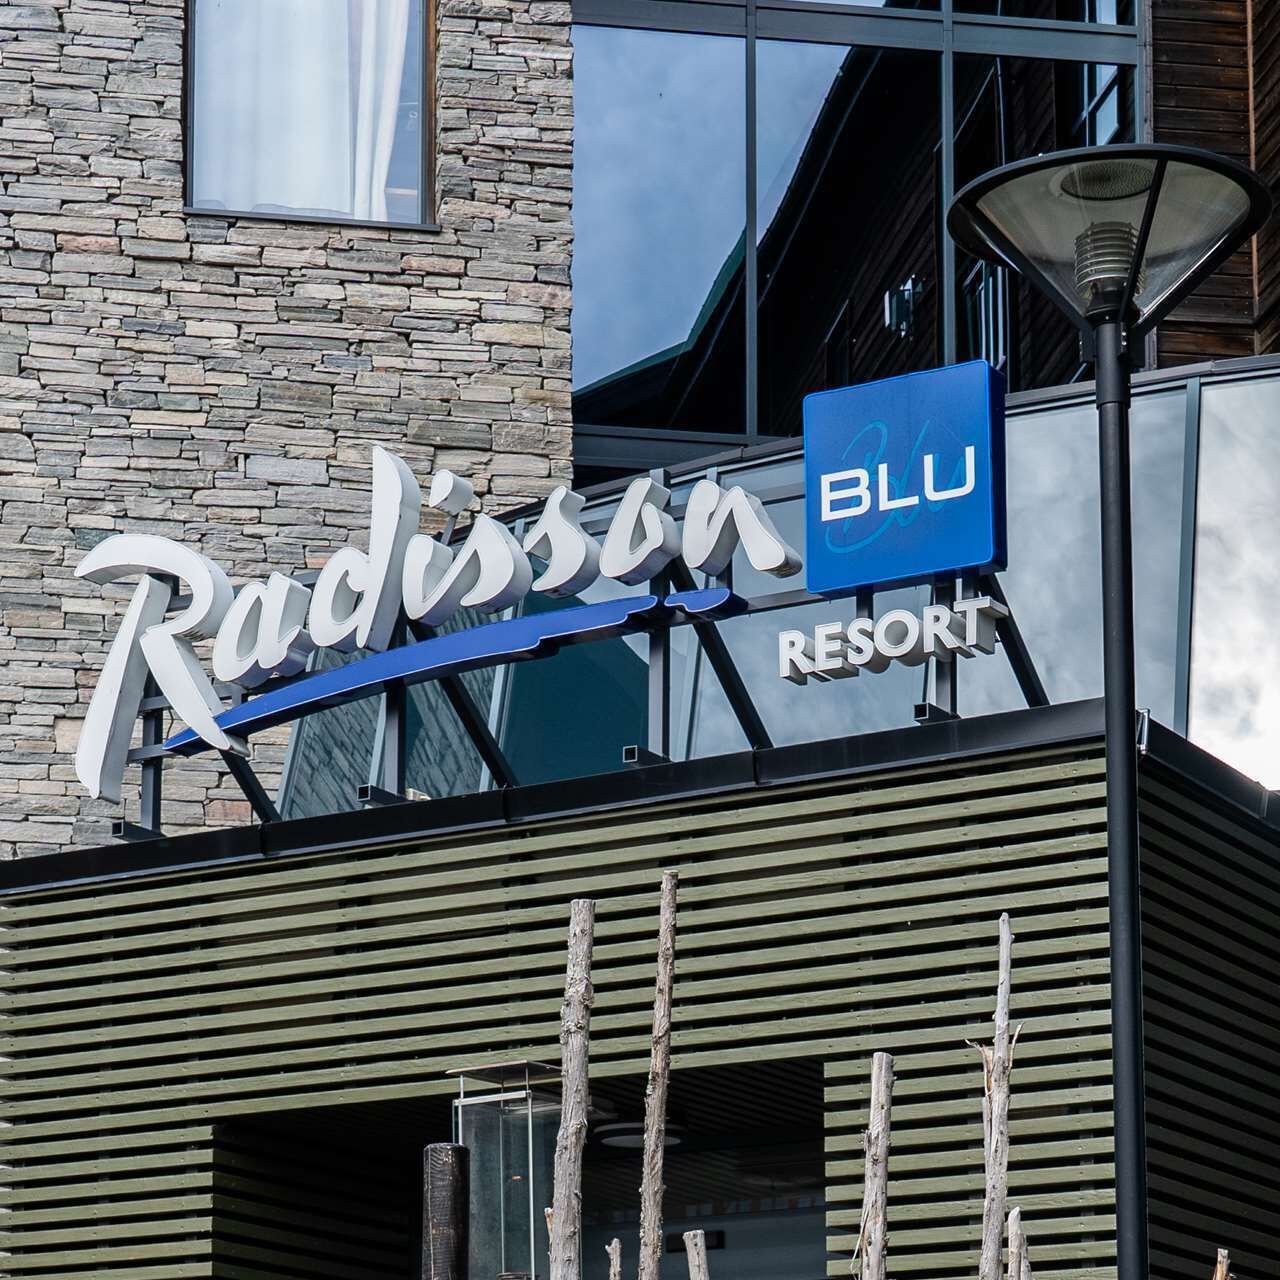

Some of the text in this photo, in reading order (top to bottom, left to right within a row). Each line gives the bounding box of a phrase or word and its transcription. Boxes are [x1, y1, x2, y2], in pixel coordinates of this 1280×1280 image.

[820, 445, 976, 522] BLU
[74, 446, 803, 797] Radisson
[779, 597, 1006, 685] RESORT
